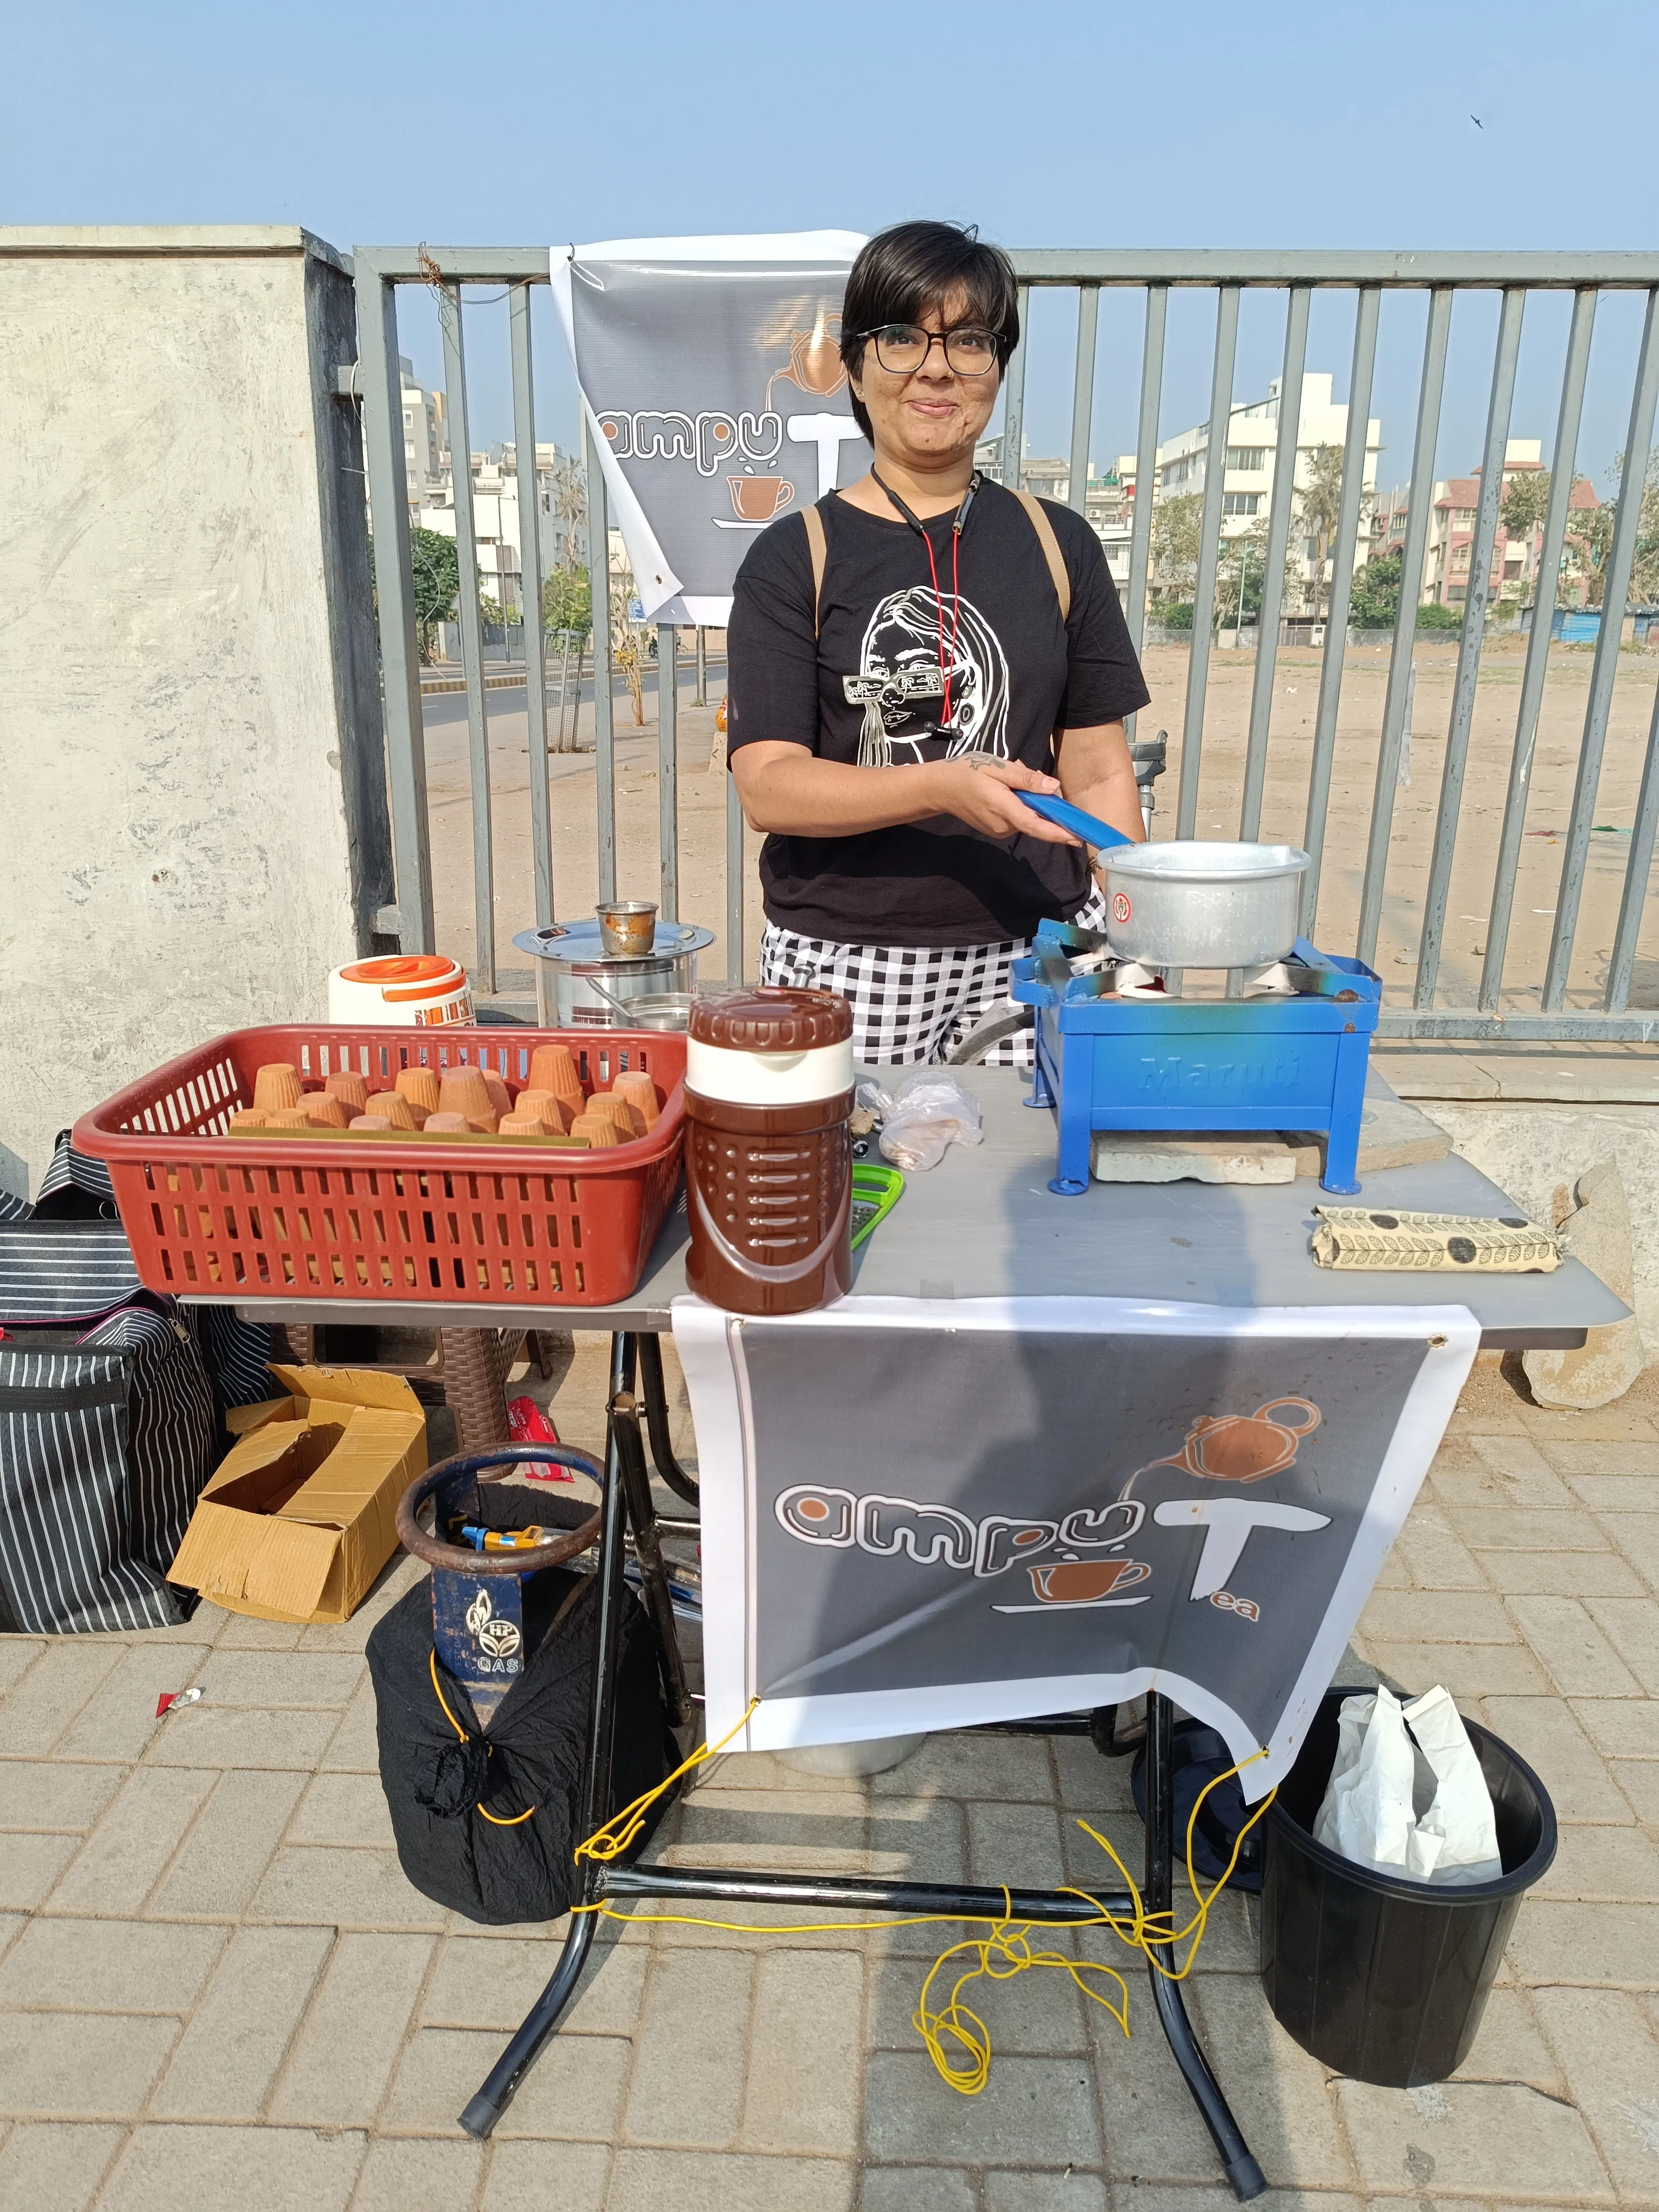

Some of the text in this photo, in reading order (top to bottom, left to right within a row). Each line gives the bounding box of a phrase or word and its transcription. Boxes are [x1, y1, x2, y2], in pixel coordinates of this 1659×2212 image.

[1137, 1056, 1301, 1090] Maruti
[489, 1624, 512, 1636] HP
[477, 1656, 519, 1673] GAS
